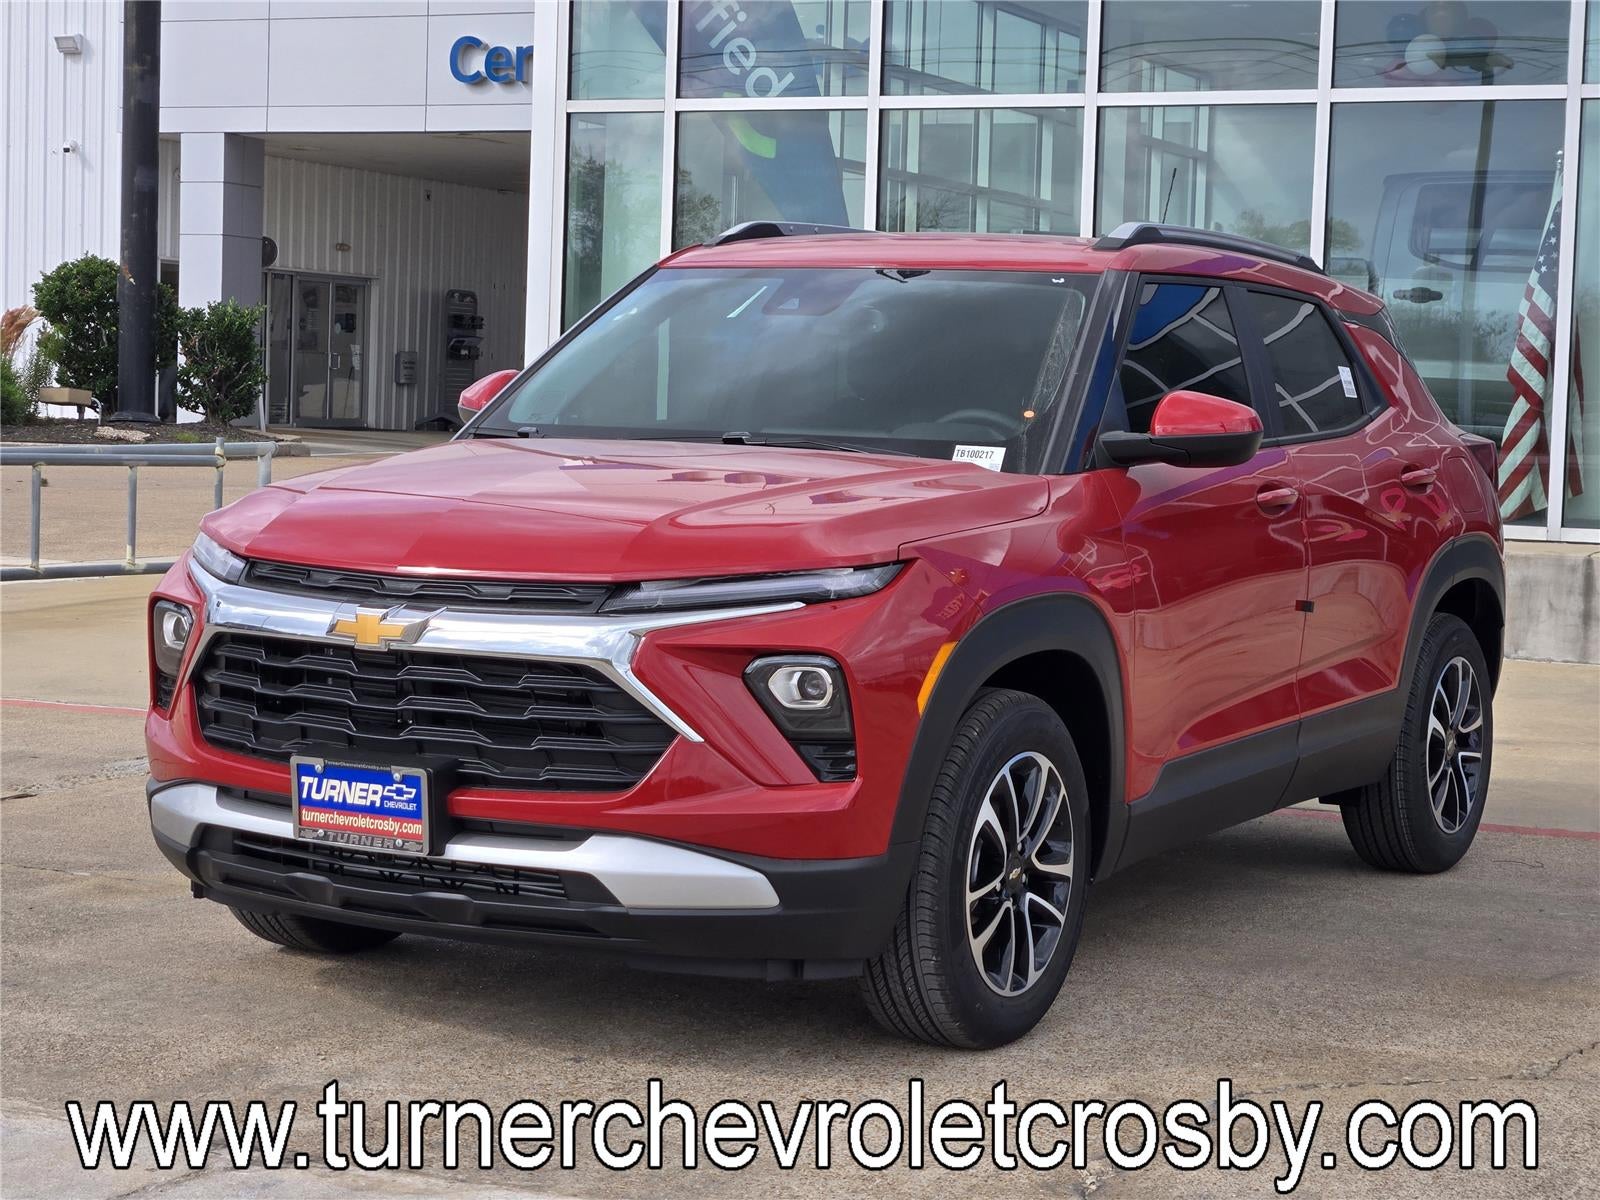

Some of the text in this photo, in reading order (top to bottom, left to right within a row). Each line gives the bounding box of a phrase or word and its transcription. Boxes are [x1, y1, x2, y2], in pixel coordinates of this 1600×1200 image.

[955, 449, 994, 459] TB100217
[301, 776, 383, 807] TURNER
[384, 800, 417, 811] CHEVROLET
[302, 808, 422, 836] turnerchevroletcrosby.com
[326, 831, 395, 849] TURNER
